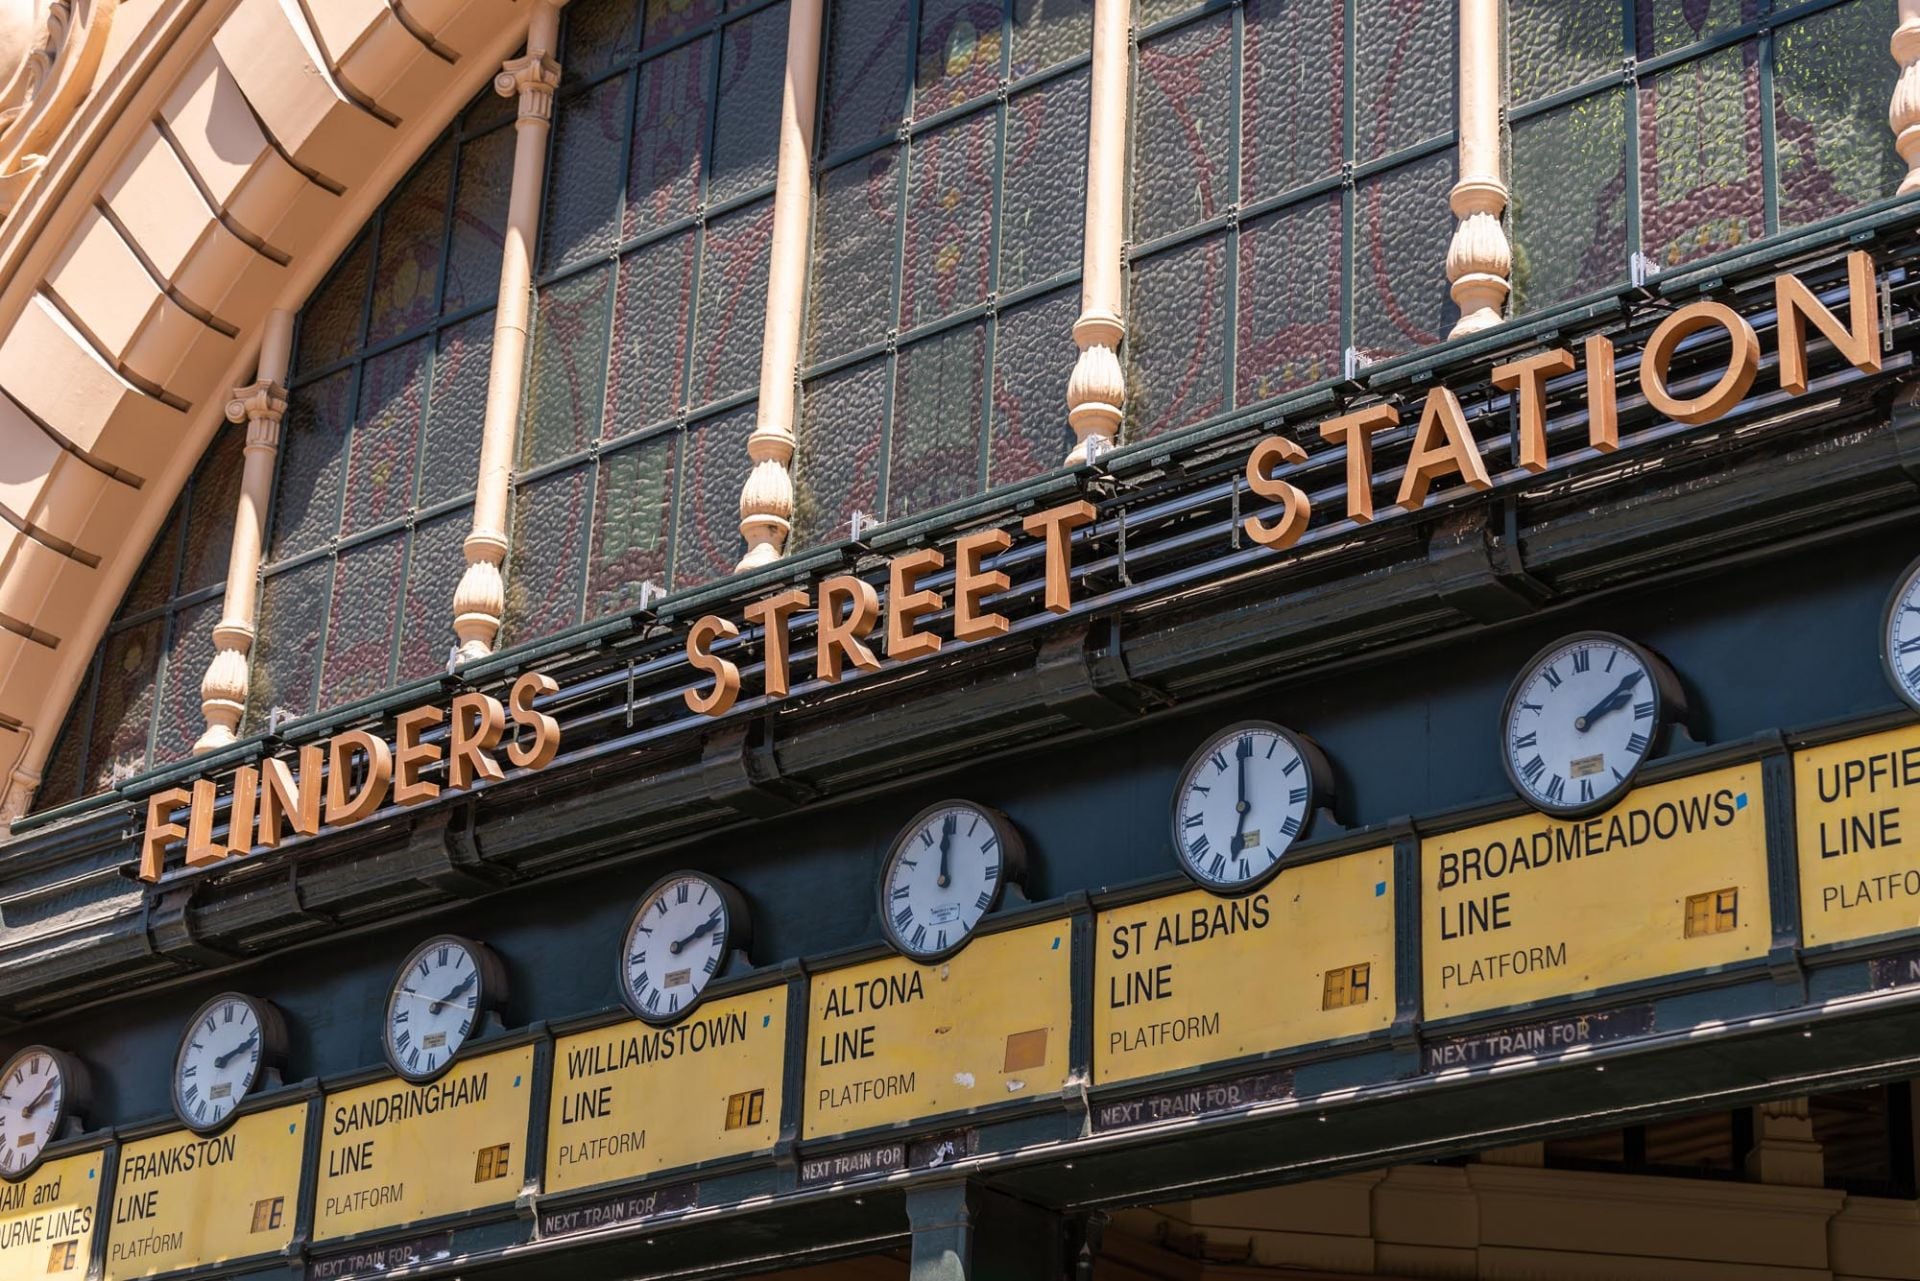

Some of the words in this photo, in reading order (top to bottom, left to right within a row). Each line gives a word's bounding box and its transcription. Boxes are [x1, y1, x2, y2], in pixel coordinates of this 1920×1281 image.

[139, 672, 560, 883] FLINDERS
[684, 500, 1097, 716] STREET
[1244, 250, 1882, 550] STATION
[1439, 789, 1735, 889] BROADMEADOWS
[1820, 807, 1901, 859] LINE
[1112, 921, 1147, 960] ST
[1155, 894, 1270, 951] ALBANS
[1440, 892, 1511, 941] LINE
[1110, 963, 1173, 1009] LINE
[1441, 942, 1567, 989] PLATFORM
[823, 970, 924, 1021] ALTONA
[568, 1011, 747, 1081] WILLIAMSTOWN
[820, 1025, 876, 1067] LINE
[1110, 1012, 1220, 1054] PLATFORM
[1432, 1040, 1480, 1067] NEXT
[1486, 1030, 1545, 1055] TRAIN
[1551, 1020, 1591, 1044] FOR
[334, 1073, 487, 1136] SANDRINGHAM
[562, 1086, 613, 1125] LINE
[819, 1072, 916, 1110] PLATFORM
[1101, 1102, 1143, 1126] NEXT
[1150, 1091, 1200, 1117] TRAIN
[1206, 1085, 1240, 1108] FOR
[122, 1135, 236, 1185] FRANKSTON
[328, 1141, 373, 1178] LINE
[559, 1130, 645, 1166] PLATFORM
[802, 1160, 832, 1182] NEXT
[834, 1153, 874, 1178] TRAIN
[876, 1147, 901, 1169] FOR
[33, 1175, 61, 1206] and
[117, 1190, 158, 1225] LINE
[326, 1183, 403, 1217] PLATFORM
[46, 1206, 92, 1240] LINES
[545, 1211, 580, 1234] NEXT
[583, 1203, 624, 1227] TRAIN
[627, 1194, 657, 1221] FOR
[112, 1232, 183, 1262] PLATFORM
[314, 1259, 346, 1279] NEXT
[350, 1250, 385, 1272] TRAIN
[388, 1246, 413, 1266] FOR
